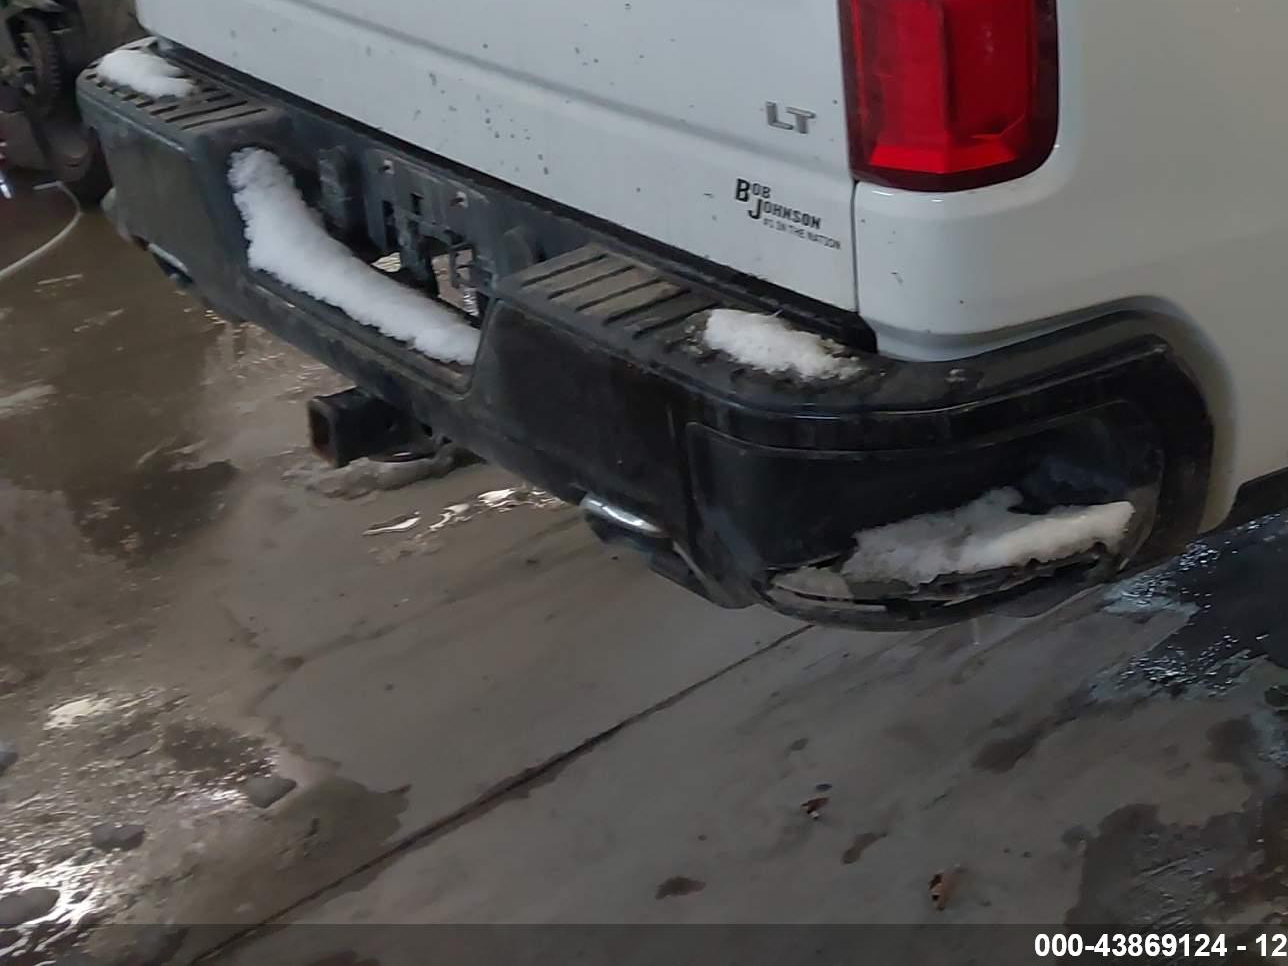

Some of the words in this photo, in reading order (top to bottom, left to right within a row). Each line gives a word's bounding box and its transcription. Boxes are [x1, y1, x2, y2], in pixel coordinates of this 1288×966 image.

[765, 100, 817, 134] LT
[735, 177, 772, 203] BOB
[747, 198, 822, 230] JOHNSON
